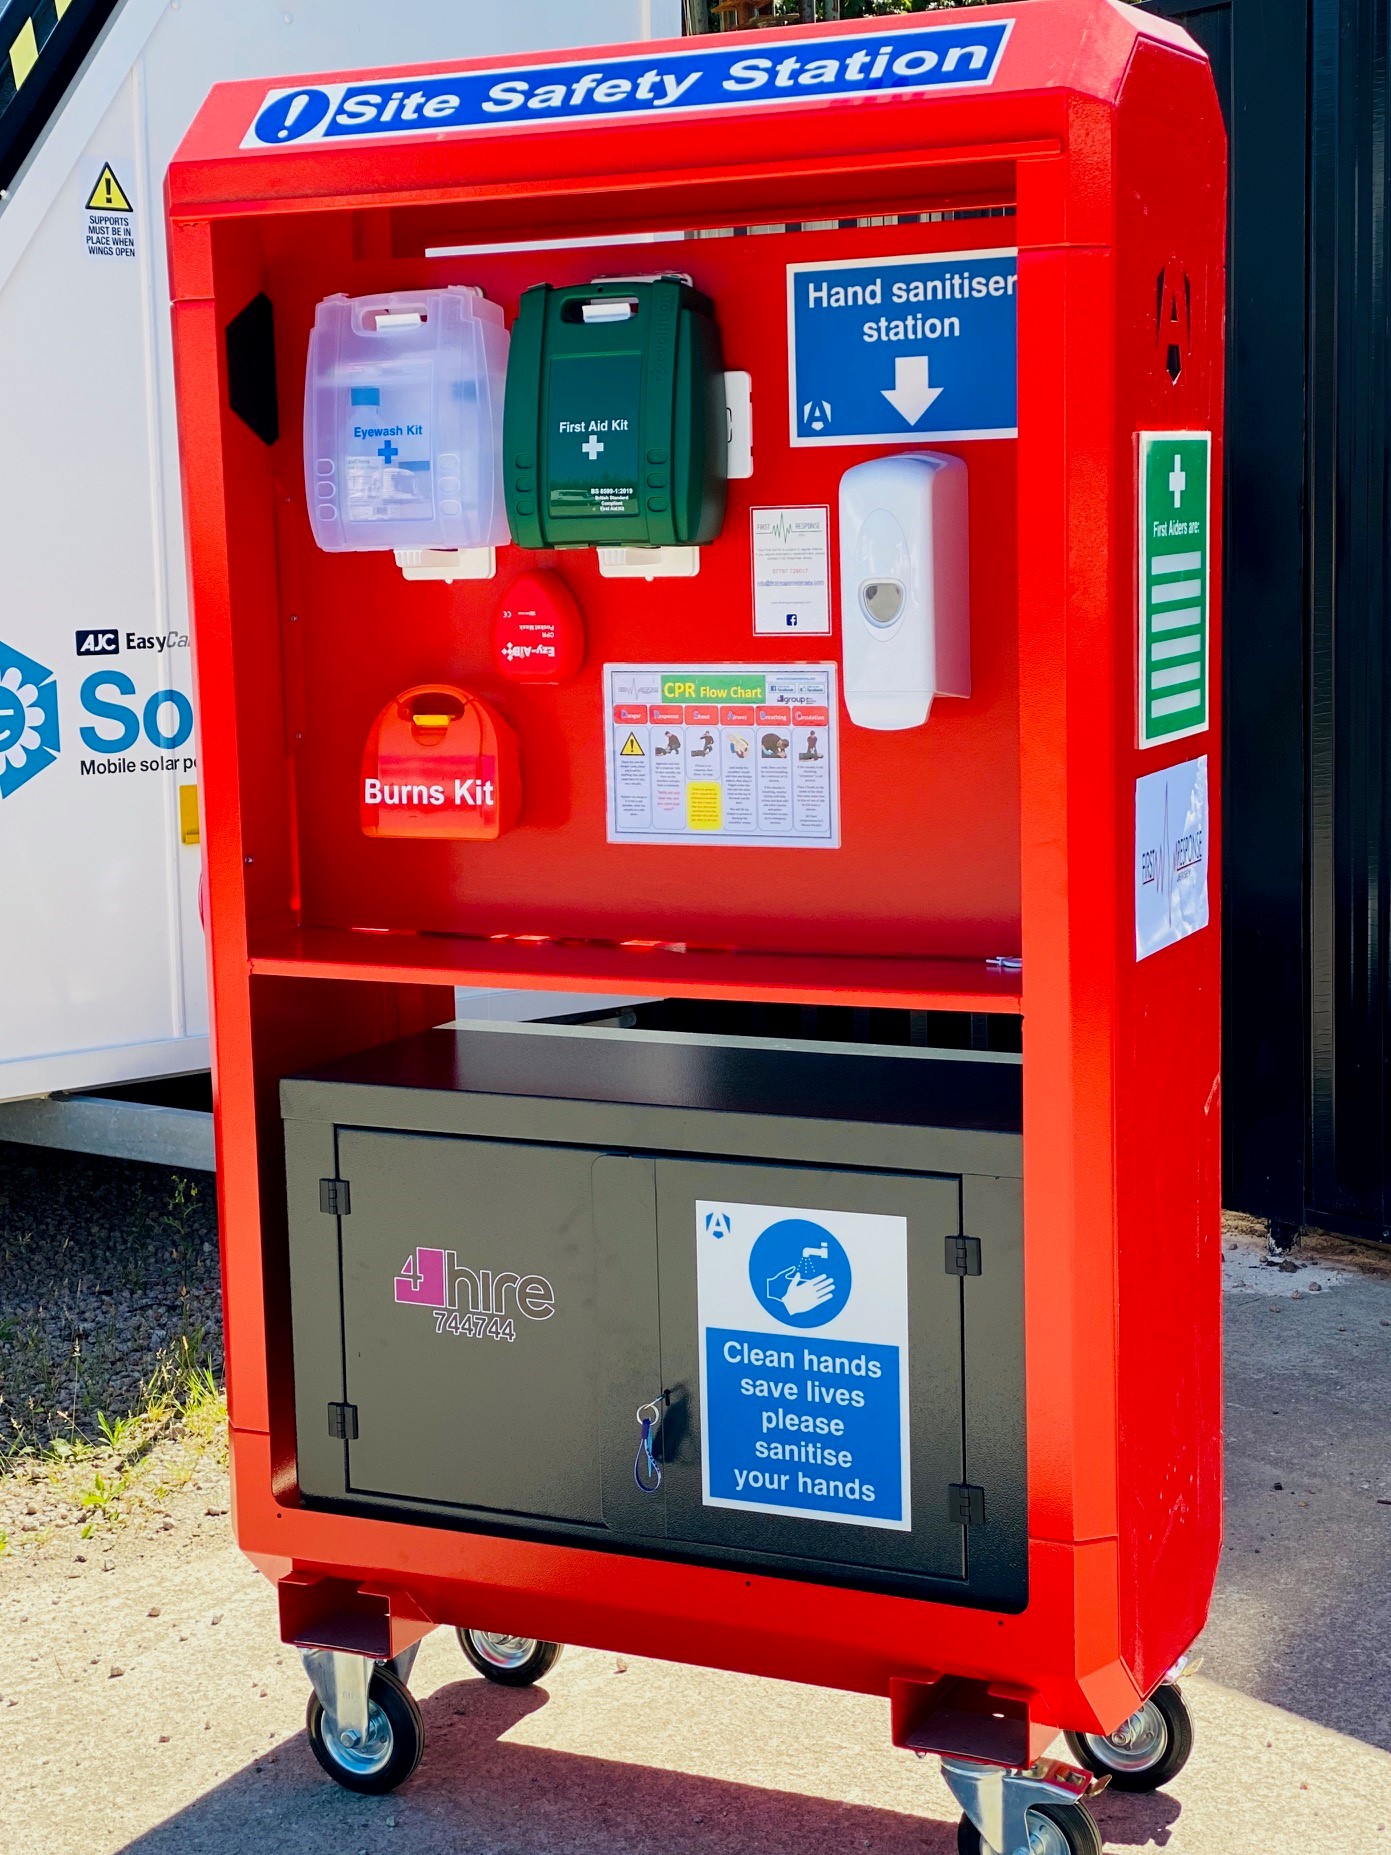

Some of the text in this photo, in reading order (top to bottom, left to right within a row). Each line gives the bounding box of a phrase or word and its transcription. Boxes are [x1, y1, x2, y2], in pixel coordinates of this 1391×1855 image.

[335, 44, 989, 125] Site Safety Station
[89, 215, 129, 226] SUPPORTS
[88, 225, 131, 237] MUST BE IN
[86, 235, 134, 247] PLACE WHEN
[88, 245, 136, 257] WINGS OPEN
[808, 271, 1018, 309] Hand sanitiser
[862, 313, 960, 343] station
[353, 425, 423, 440] Eyewash Kit
[559, 419, 628, 433] First Aid Kit
[756, 522, 820, 531] FIRST RESPONSE
[1153, 520, 1167, 538] First
[1168, 519, 1188, 535] Aiders
[80, 630, 191, 653] AJC EasyCa
[663, 681, 696, 698] CPR
[700, 685, 727, 698] Flow
[730, 685, 762, 698] Chart
[621, 709, 642, 720] Danger
[653, 709, 680, 720] Response
[693, 709, 710, 720] Shout
[727, 709, 748, 721] Airway
[760, 710, 787, 722] Breathing
[795, 710, 825, 721] Circulation
[80, 755, 197, 776] Mobile solar p
[364, 778, 494, 806] Burns Kit
[433, 1310, 516, 1342] 744744
[722, 1340, 882, 1379] Clean hands
[740, 1378, 865, 1408] save lives
[762, 1408, 845, 1436] please
[755, 1440, 852, 1468] sanitise
[733, 1467, 876, 1502] your hands
